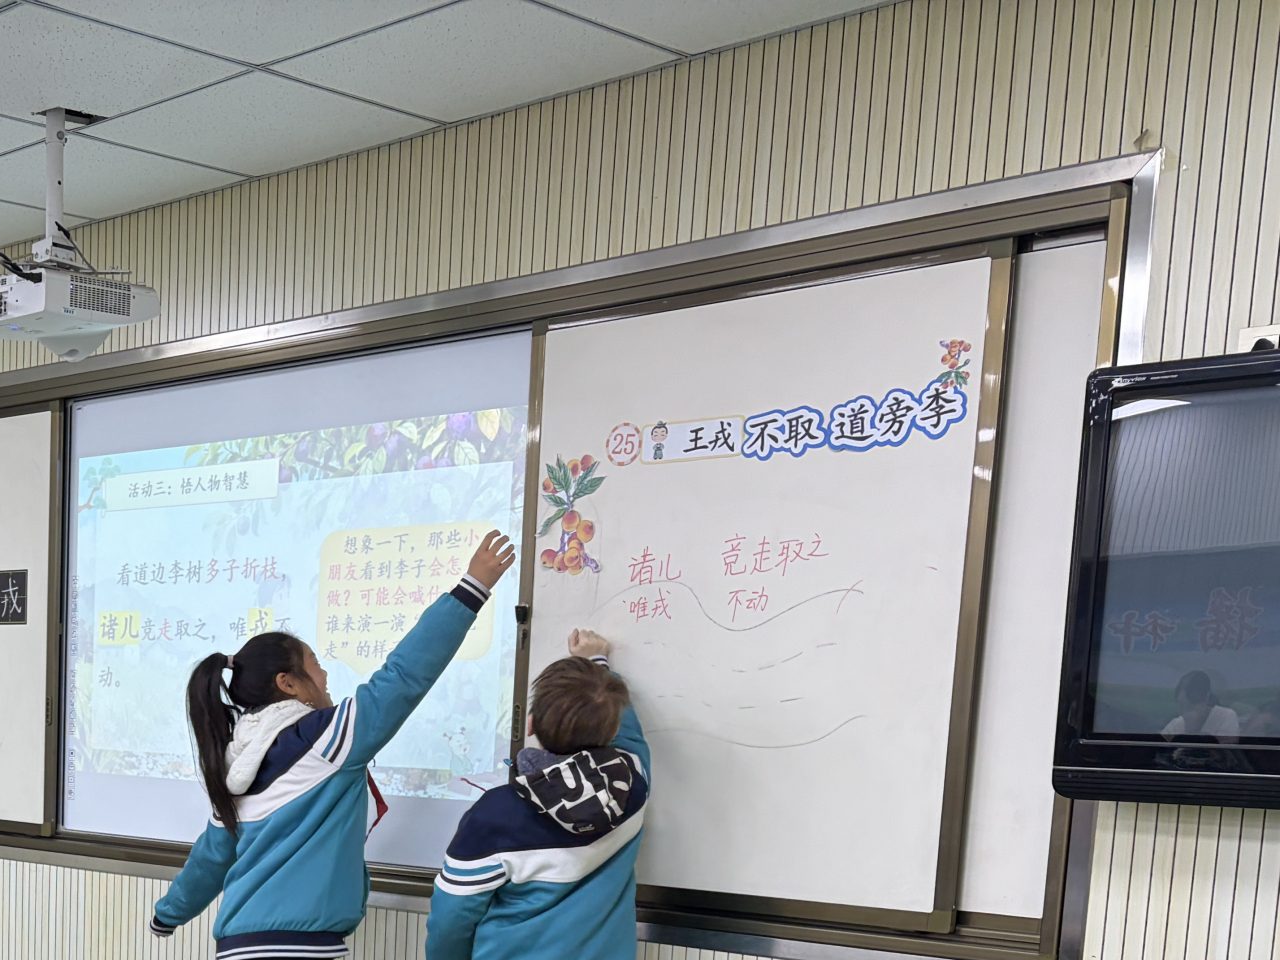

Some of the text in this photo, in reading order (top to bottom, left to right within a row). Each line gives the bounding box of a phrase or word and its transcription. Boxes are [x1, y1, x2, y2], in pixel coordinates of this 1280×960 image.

[613, 432, 636, 455] 25
[628, 546, 681, 585] 诸儿
[0, 577, 22, 618] 戎
[326, 583, 455, 608] 做？可能会喊什
[629, 586, 769, 622] 唯戎 不动
[99, 666, 121, 688] 动。
